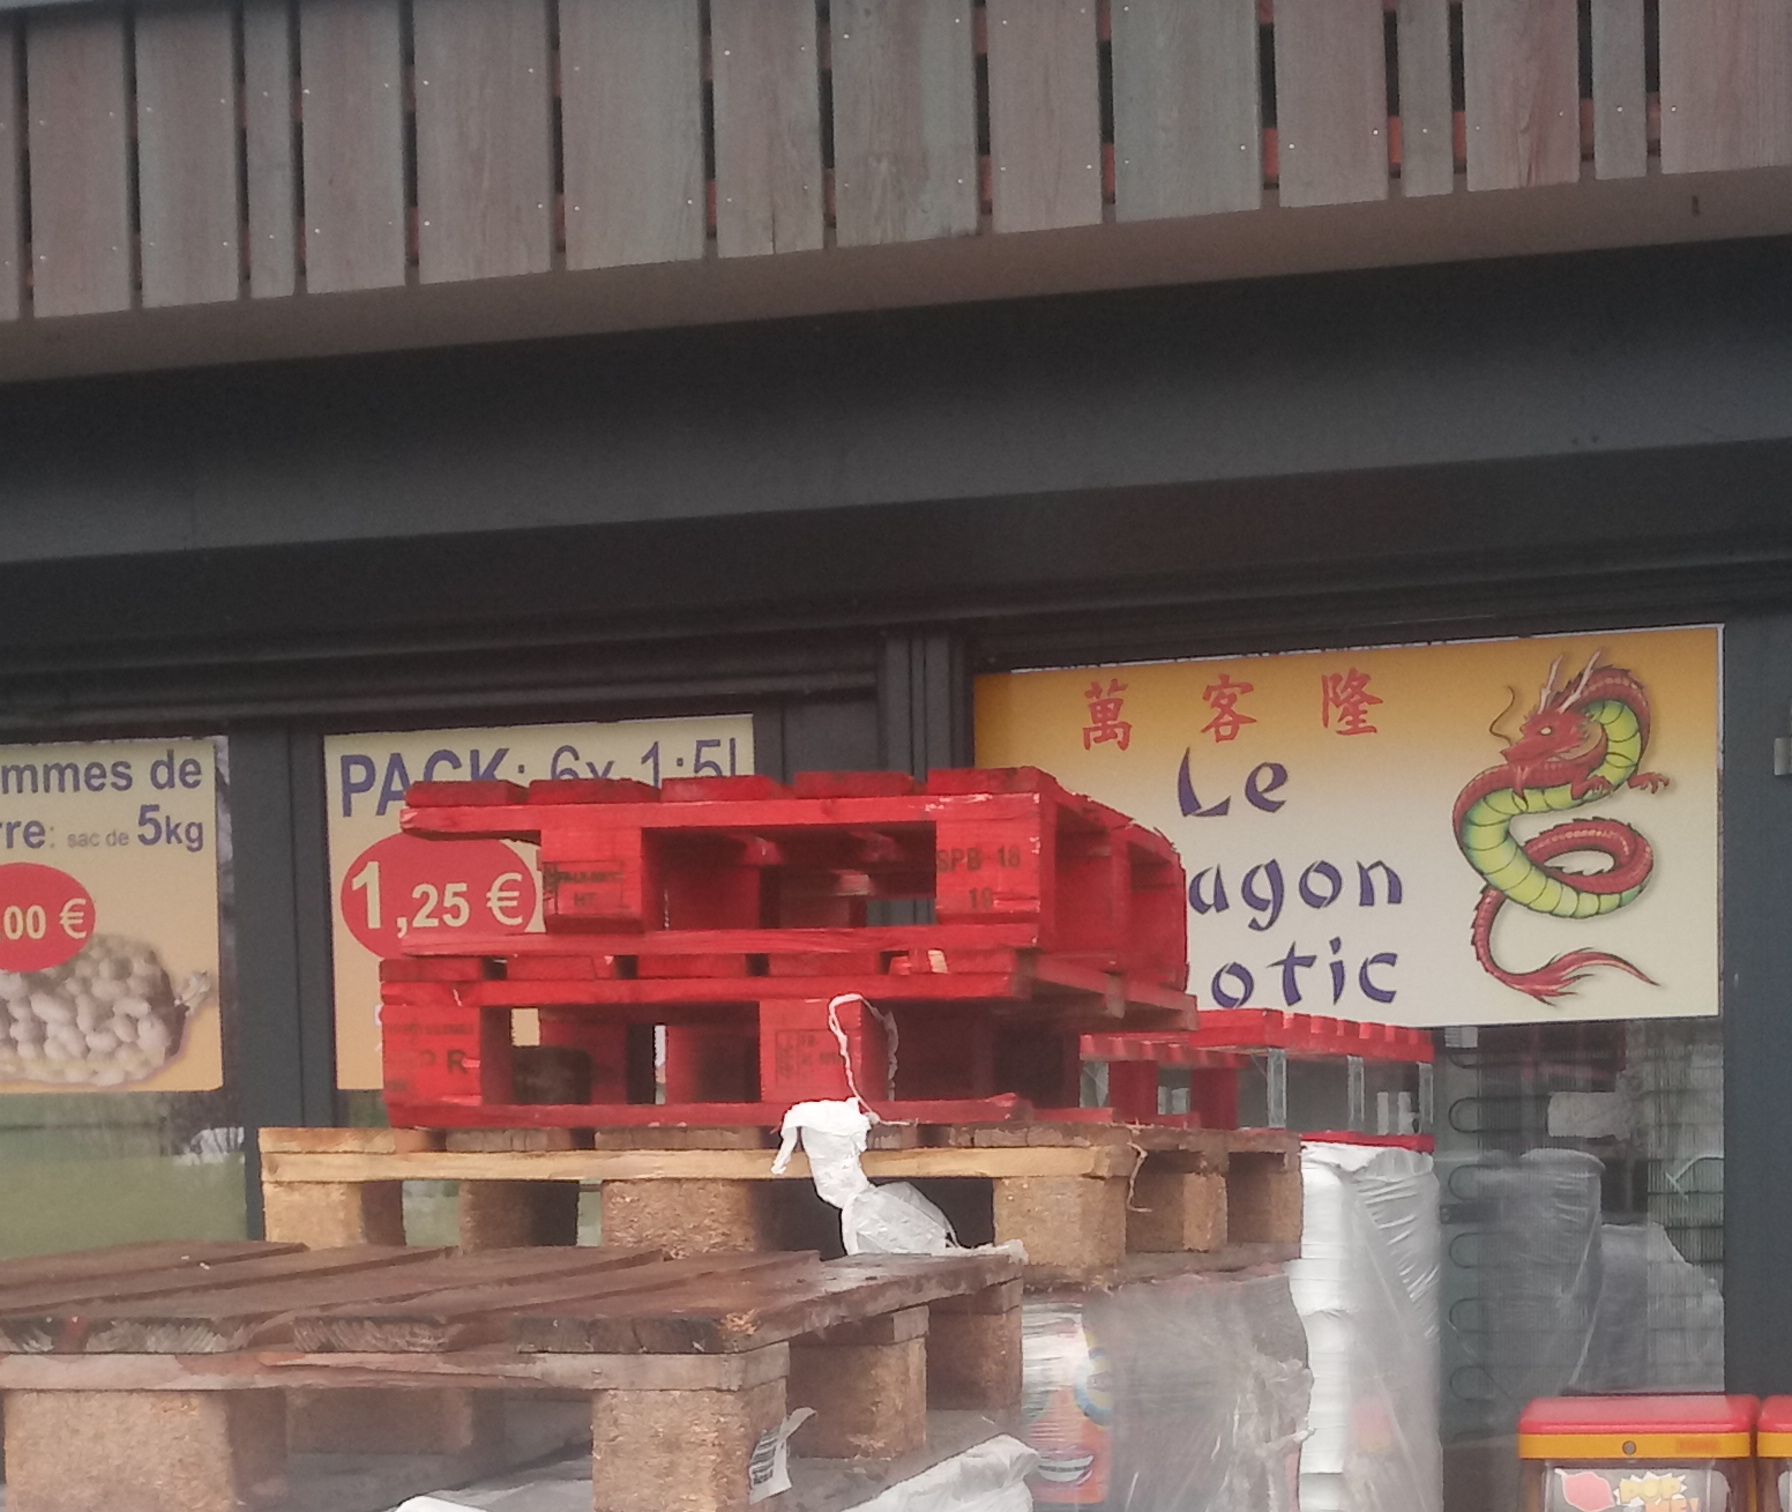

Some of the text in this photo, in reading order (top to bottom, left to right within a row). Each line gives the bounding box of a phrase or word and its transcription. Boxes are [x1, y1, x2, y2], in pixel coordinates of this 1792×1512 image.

[150, 750, 203, 790] de
[1178, 748, 1288, 818] Le
[67, 832, 100, 849] sac
[105, 828, 129, 848] de
[137, 804, 204, 852] 5kg
[60, 898, 88, 940] €
[351, 861, 523, 938] 1,25 €
[1189, 857, 1402, 932] agon
[1210, 937, 1398, 1010] otic
